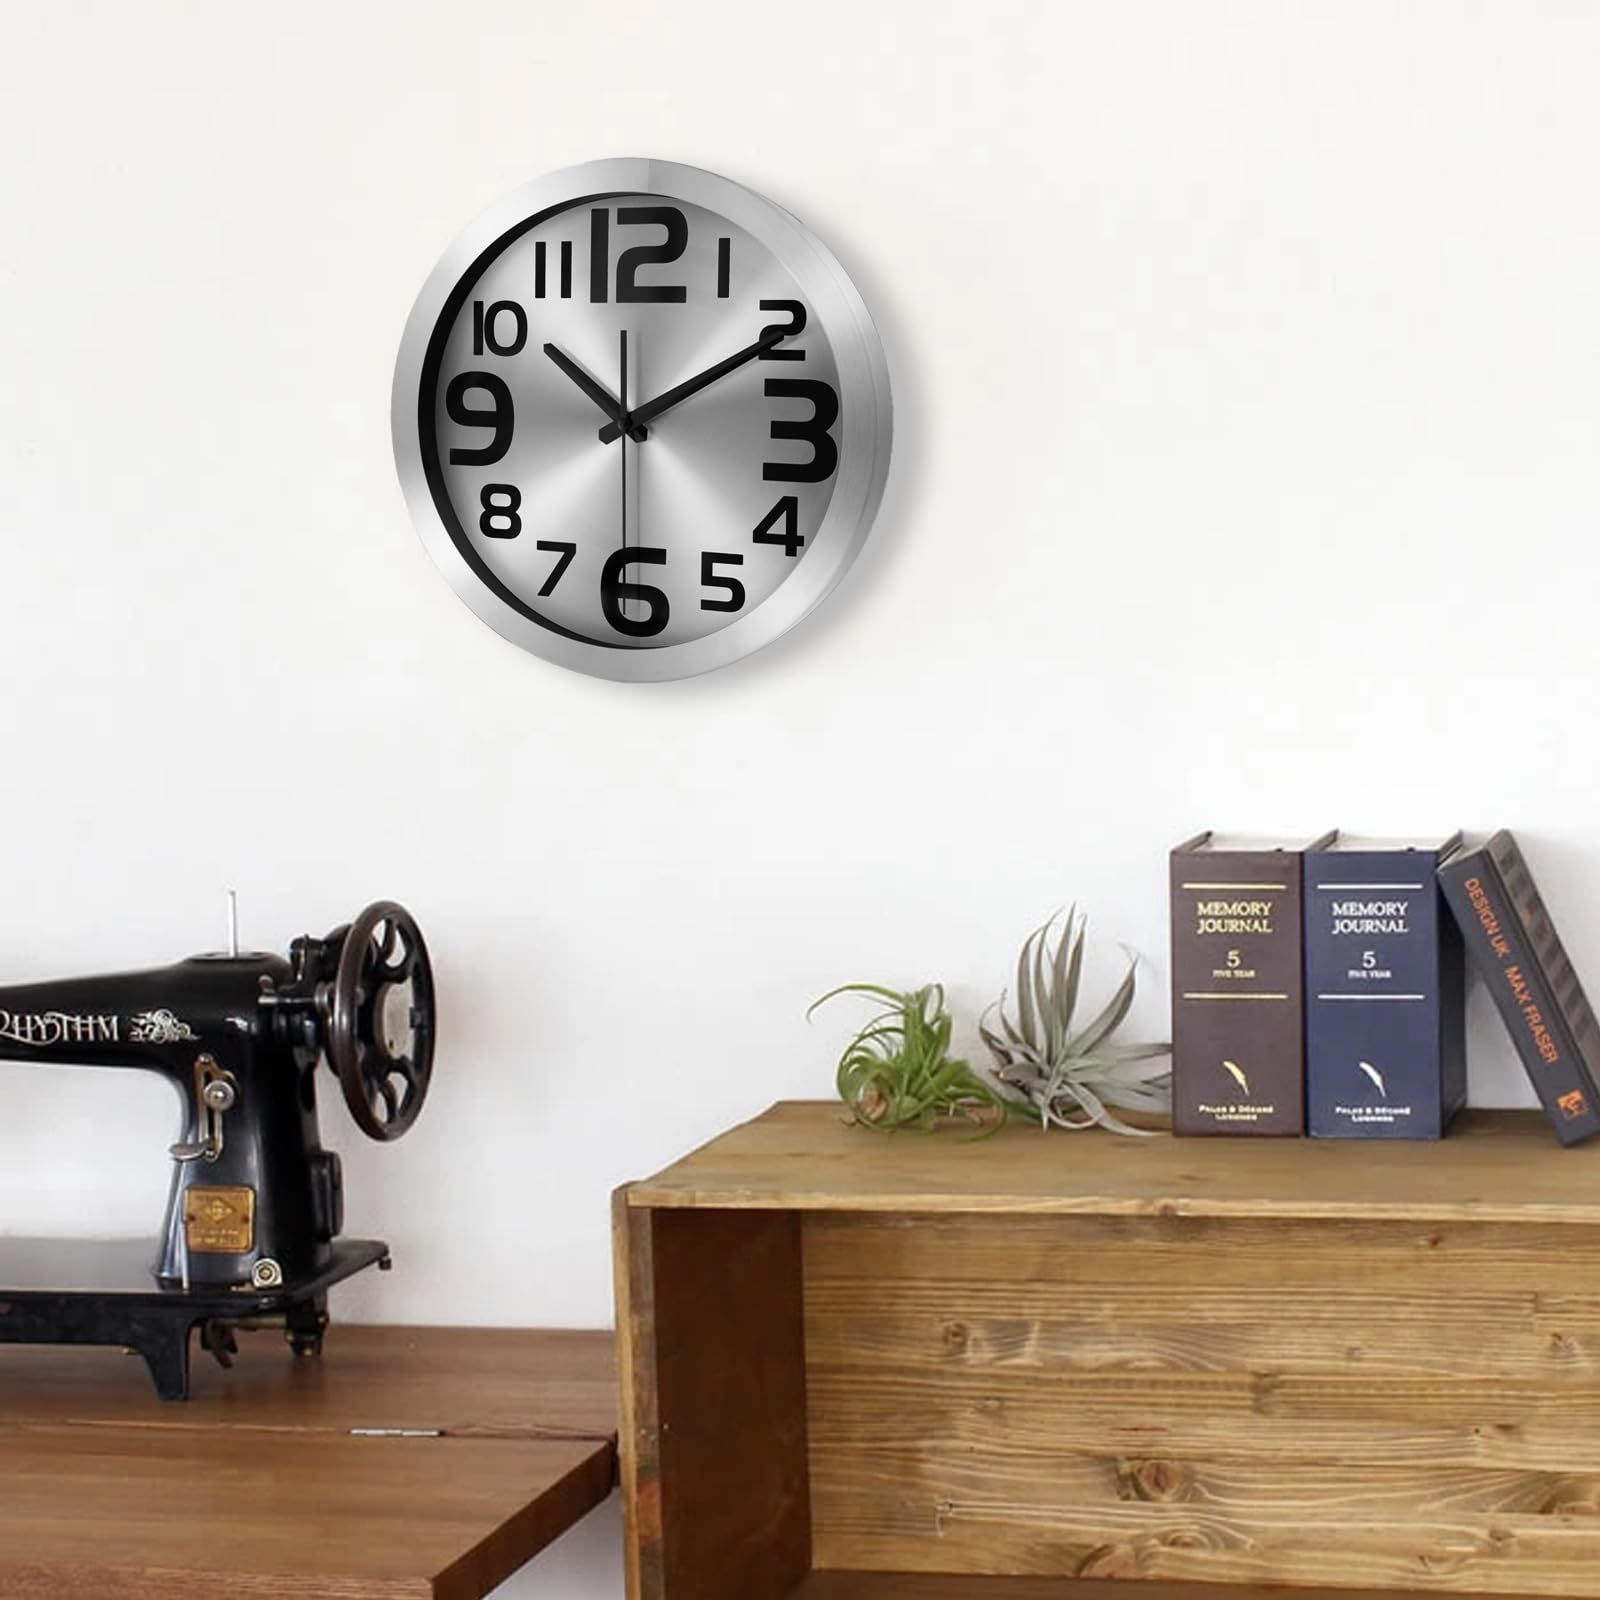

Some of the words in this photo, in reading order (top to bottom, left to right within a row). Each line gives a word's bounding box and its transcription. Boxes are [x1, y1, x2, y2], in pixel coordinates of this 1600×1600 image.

[535, 240, 572, 298] 11
[590, 206, 688, 303] 12
[717, 238, 730, 298] 1
[473, 300, 528, 356] 10
[759, 299, 807, 361] 2
[445, 371, 515, 466] 9
[763, 378, 839, 483] 3
[479, 484, 522, 539] 8
[753, 496, 804, 557] 4
[536, 540, 577, 597] 7
[601, 546, 670, 637] 6
[700, 551, 746, 612] 5
[1196, 919, 1273, 934] JOURNAL
[1197, 901, 1272, 916] MEMORY
[1331, 919, 1409, 934] JOURNAL
[1332, 901, 1409, 916] MEMORY
[1226, 950, 1241, 968] 5
[1362, 951, 1377, 969] 5
[1464, 877, 1500, 936] DESIGN
[1490, 934, 1511, 958] UK
[1504, 964, 1532, 1005] MAX
[1522, 1004, 1560, 1064] FRASER
